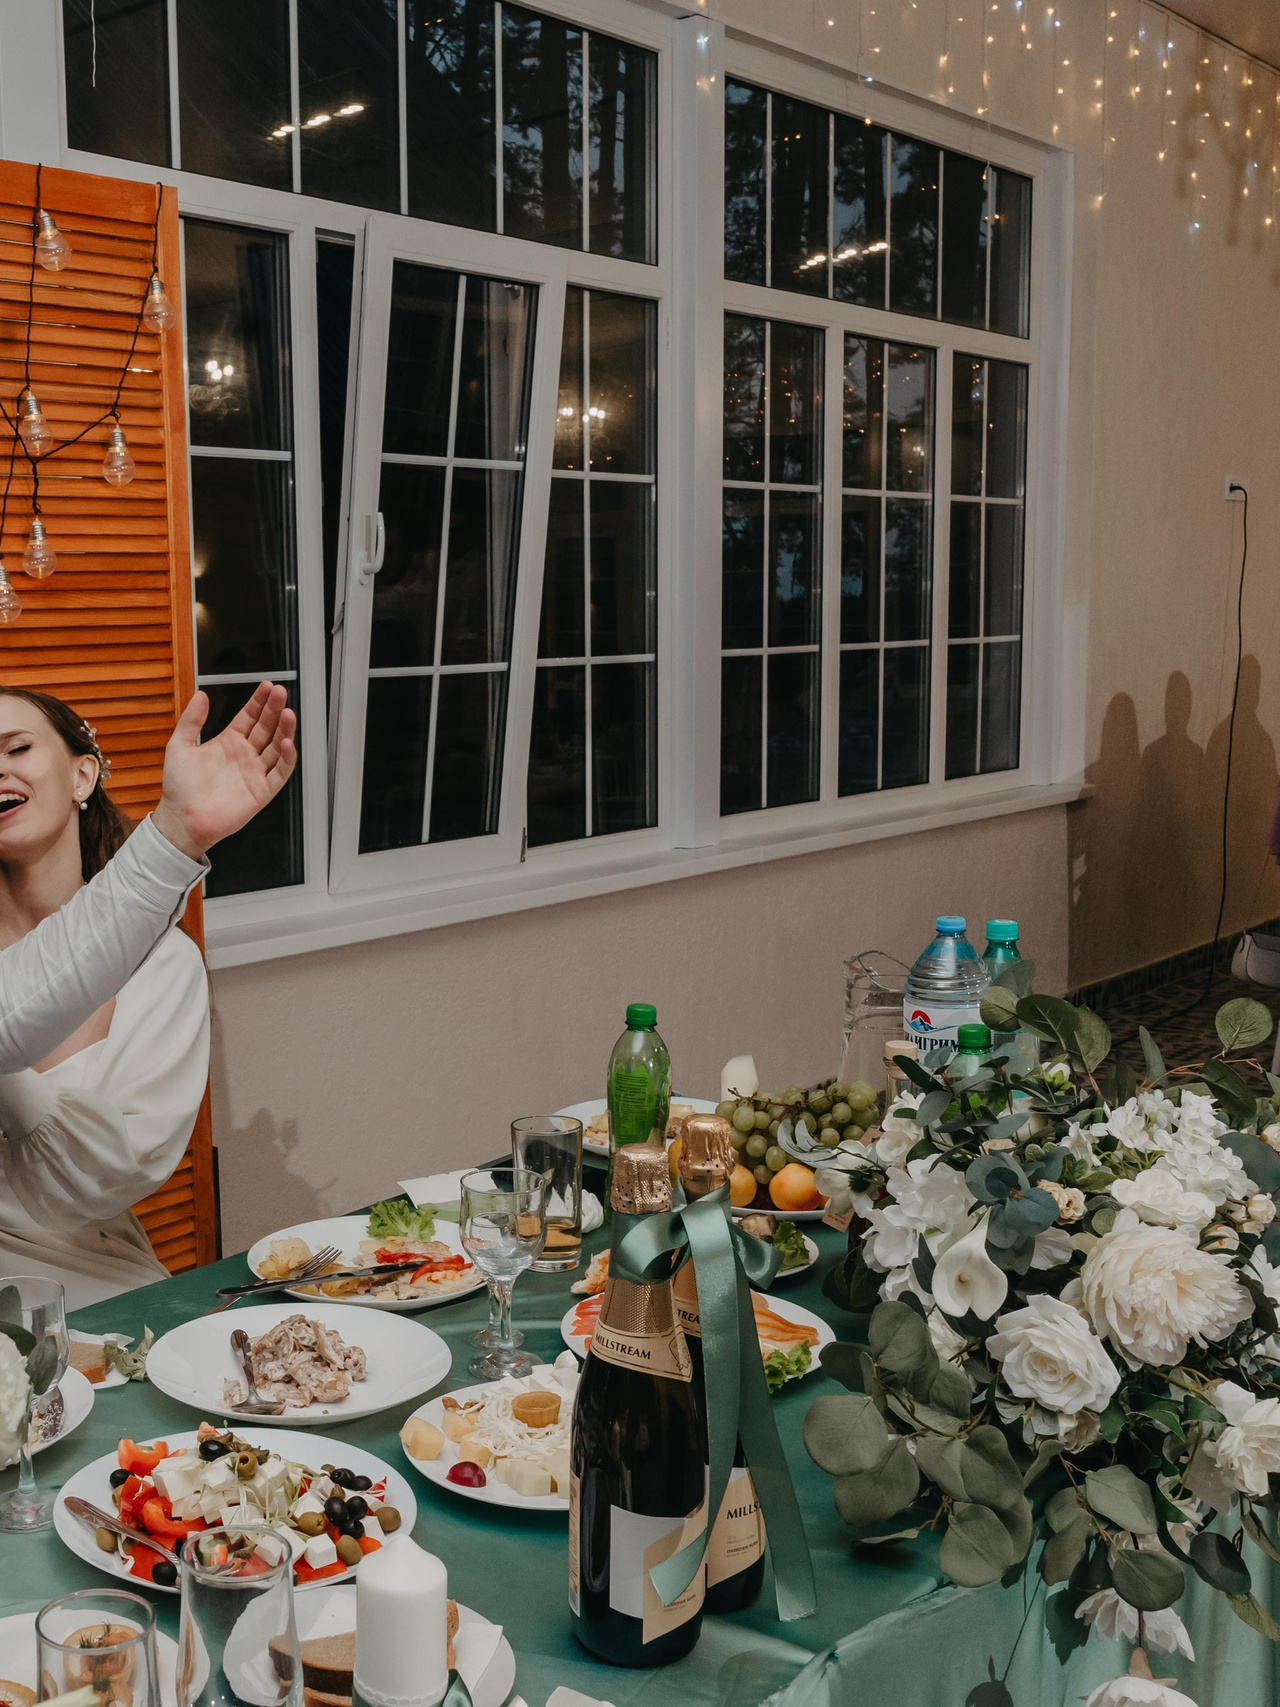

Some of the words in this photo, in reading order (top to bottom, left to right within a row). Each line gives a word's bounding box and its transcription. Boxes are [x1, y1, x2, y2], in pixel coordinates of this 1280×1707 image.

[677, 1308, 701, 1324] TREA
[595, 1332, 651, 1360] MILLSTREAM
[726, 1500, 761, 1520] MILLS
